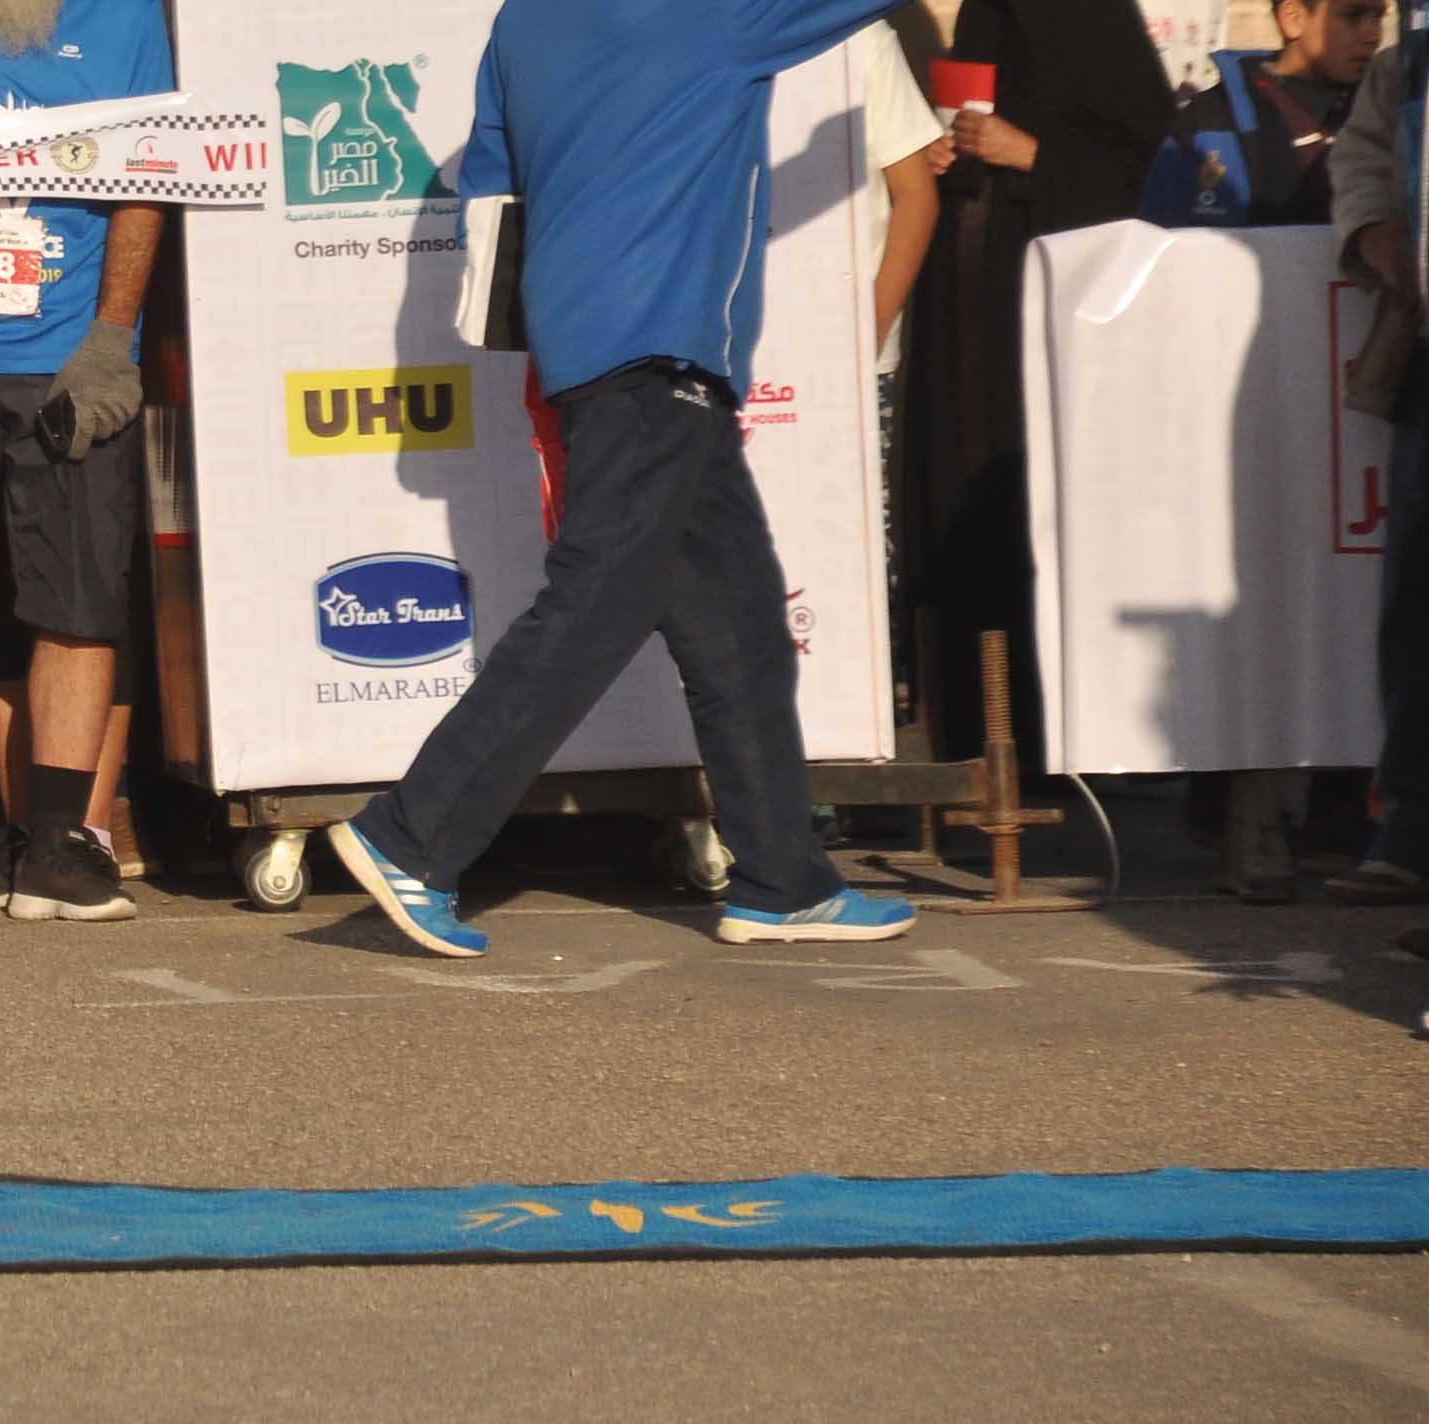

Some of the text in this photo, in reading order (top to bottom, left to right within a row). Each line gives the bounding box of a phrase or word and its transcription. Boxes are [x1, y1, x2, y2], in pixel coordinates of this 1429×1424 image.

[330, 141, 378, 166] مصر
[320, 158, 379, 196] الخير
[294, 236, 459, 259] Charity Sponso
[38, 267, 63, 282] 019
[302, 382, 454, 439] UHU
[338, 598, 466, 627] Star Trans
[316, 677, 468, 705] ELMARABE
